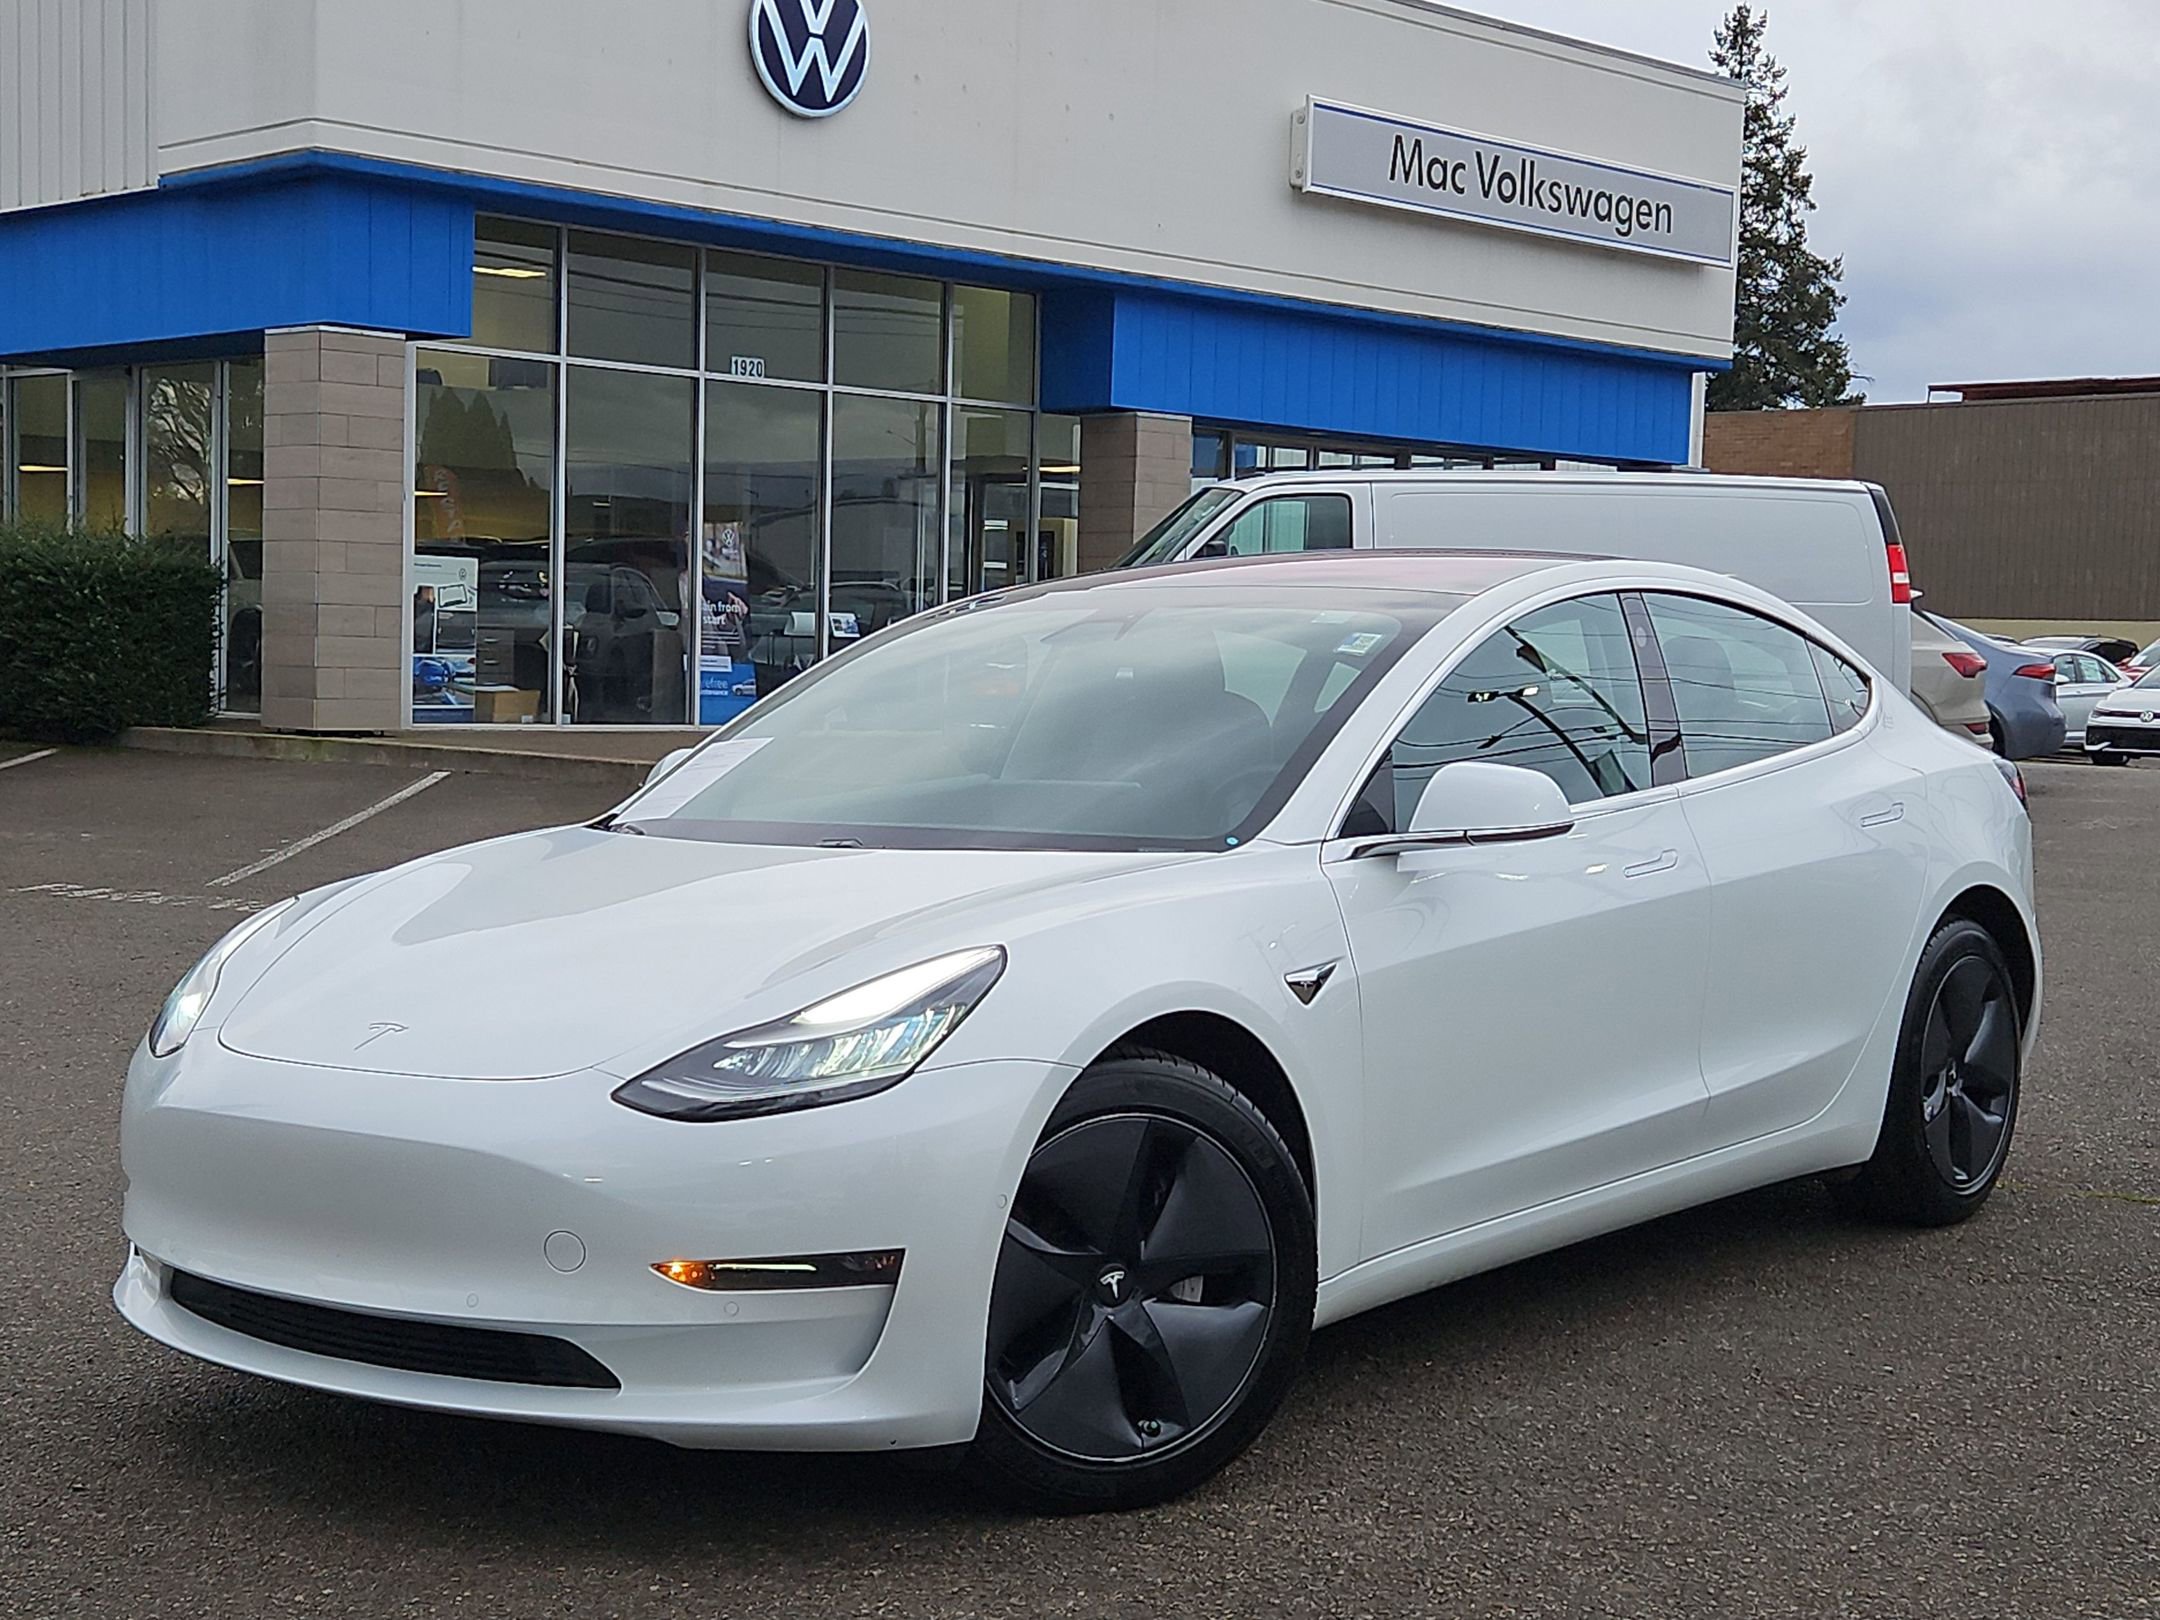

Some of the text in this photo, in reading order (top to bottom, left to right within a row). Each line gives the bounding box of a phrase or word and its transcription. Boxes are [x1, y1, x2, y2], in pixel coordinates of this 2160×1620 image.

[1388, 134, 1673, 237] Mac Volkswagen
[733, 359, 763, 377] 1920
[717, 600, 740, 613] from
[702, 616, 726, 625] start
